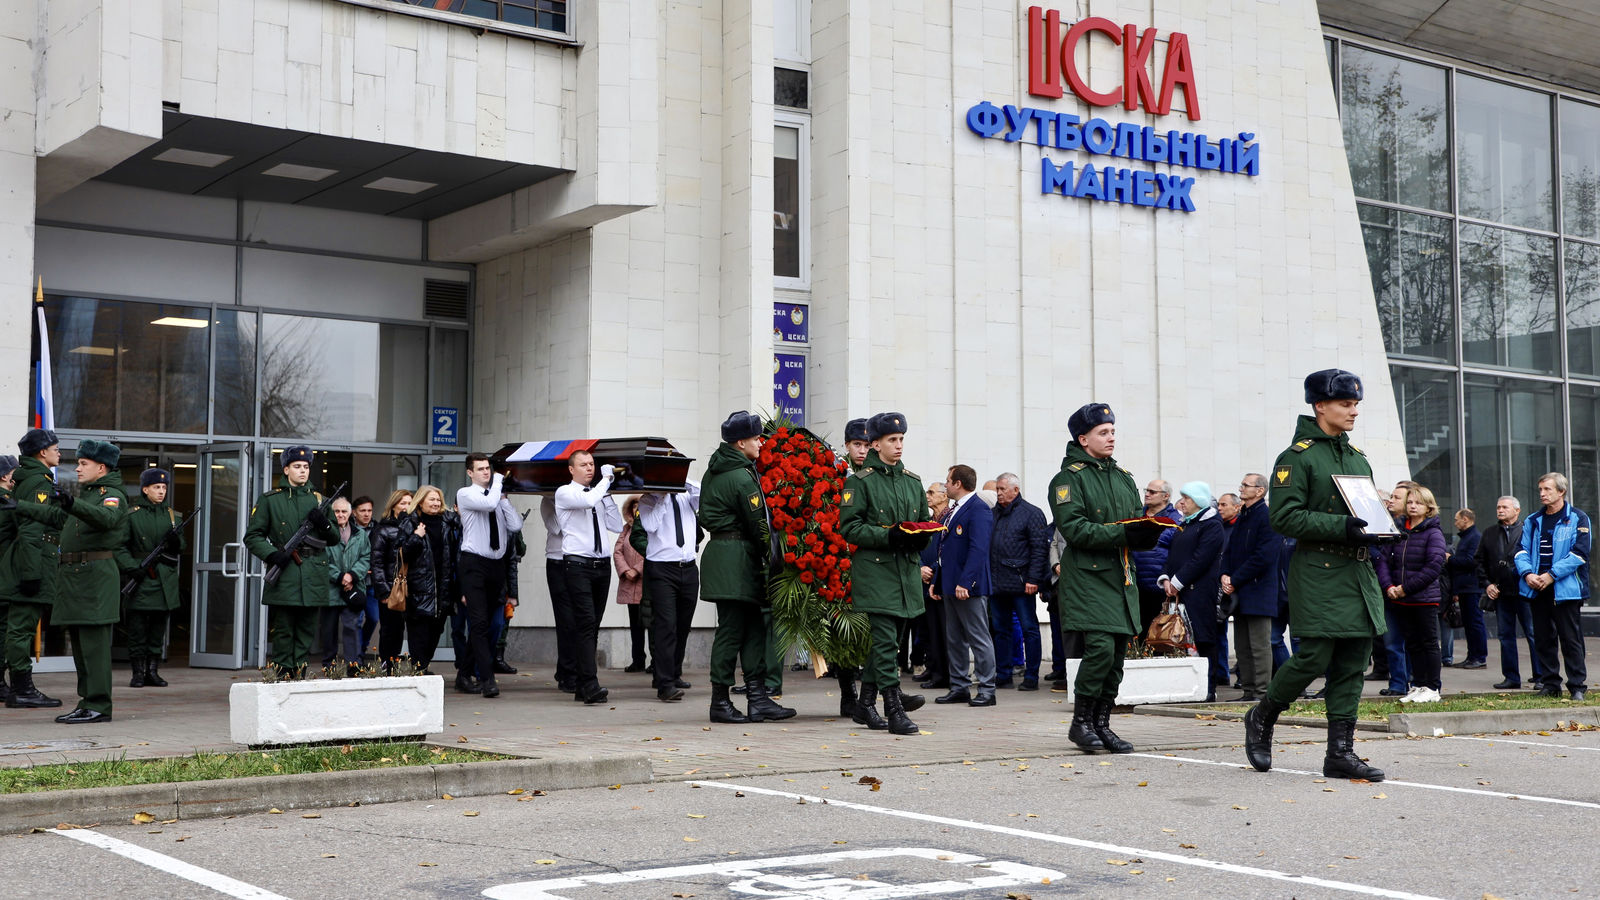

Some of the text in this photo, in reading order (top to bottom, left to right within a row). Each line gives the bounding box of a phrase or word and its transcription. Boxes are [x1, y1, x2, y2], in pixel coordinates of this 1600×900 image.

[1028, 5, 1201, 121] ЦСКА
[966, 101, 1260, 176] ФУТБОЛЬНЫЙ
[1041, 157, 1196, 212] МАНЕЖ
[437, 415, 453, 435] 2
